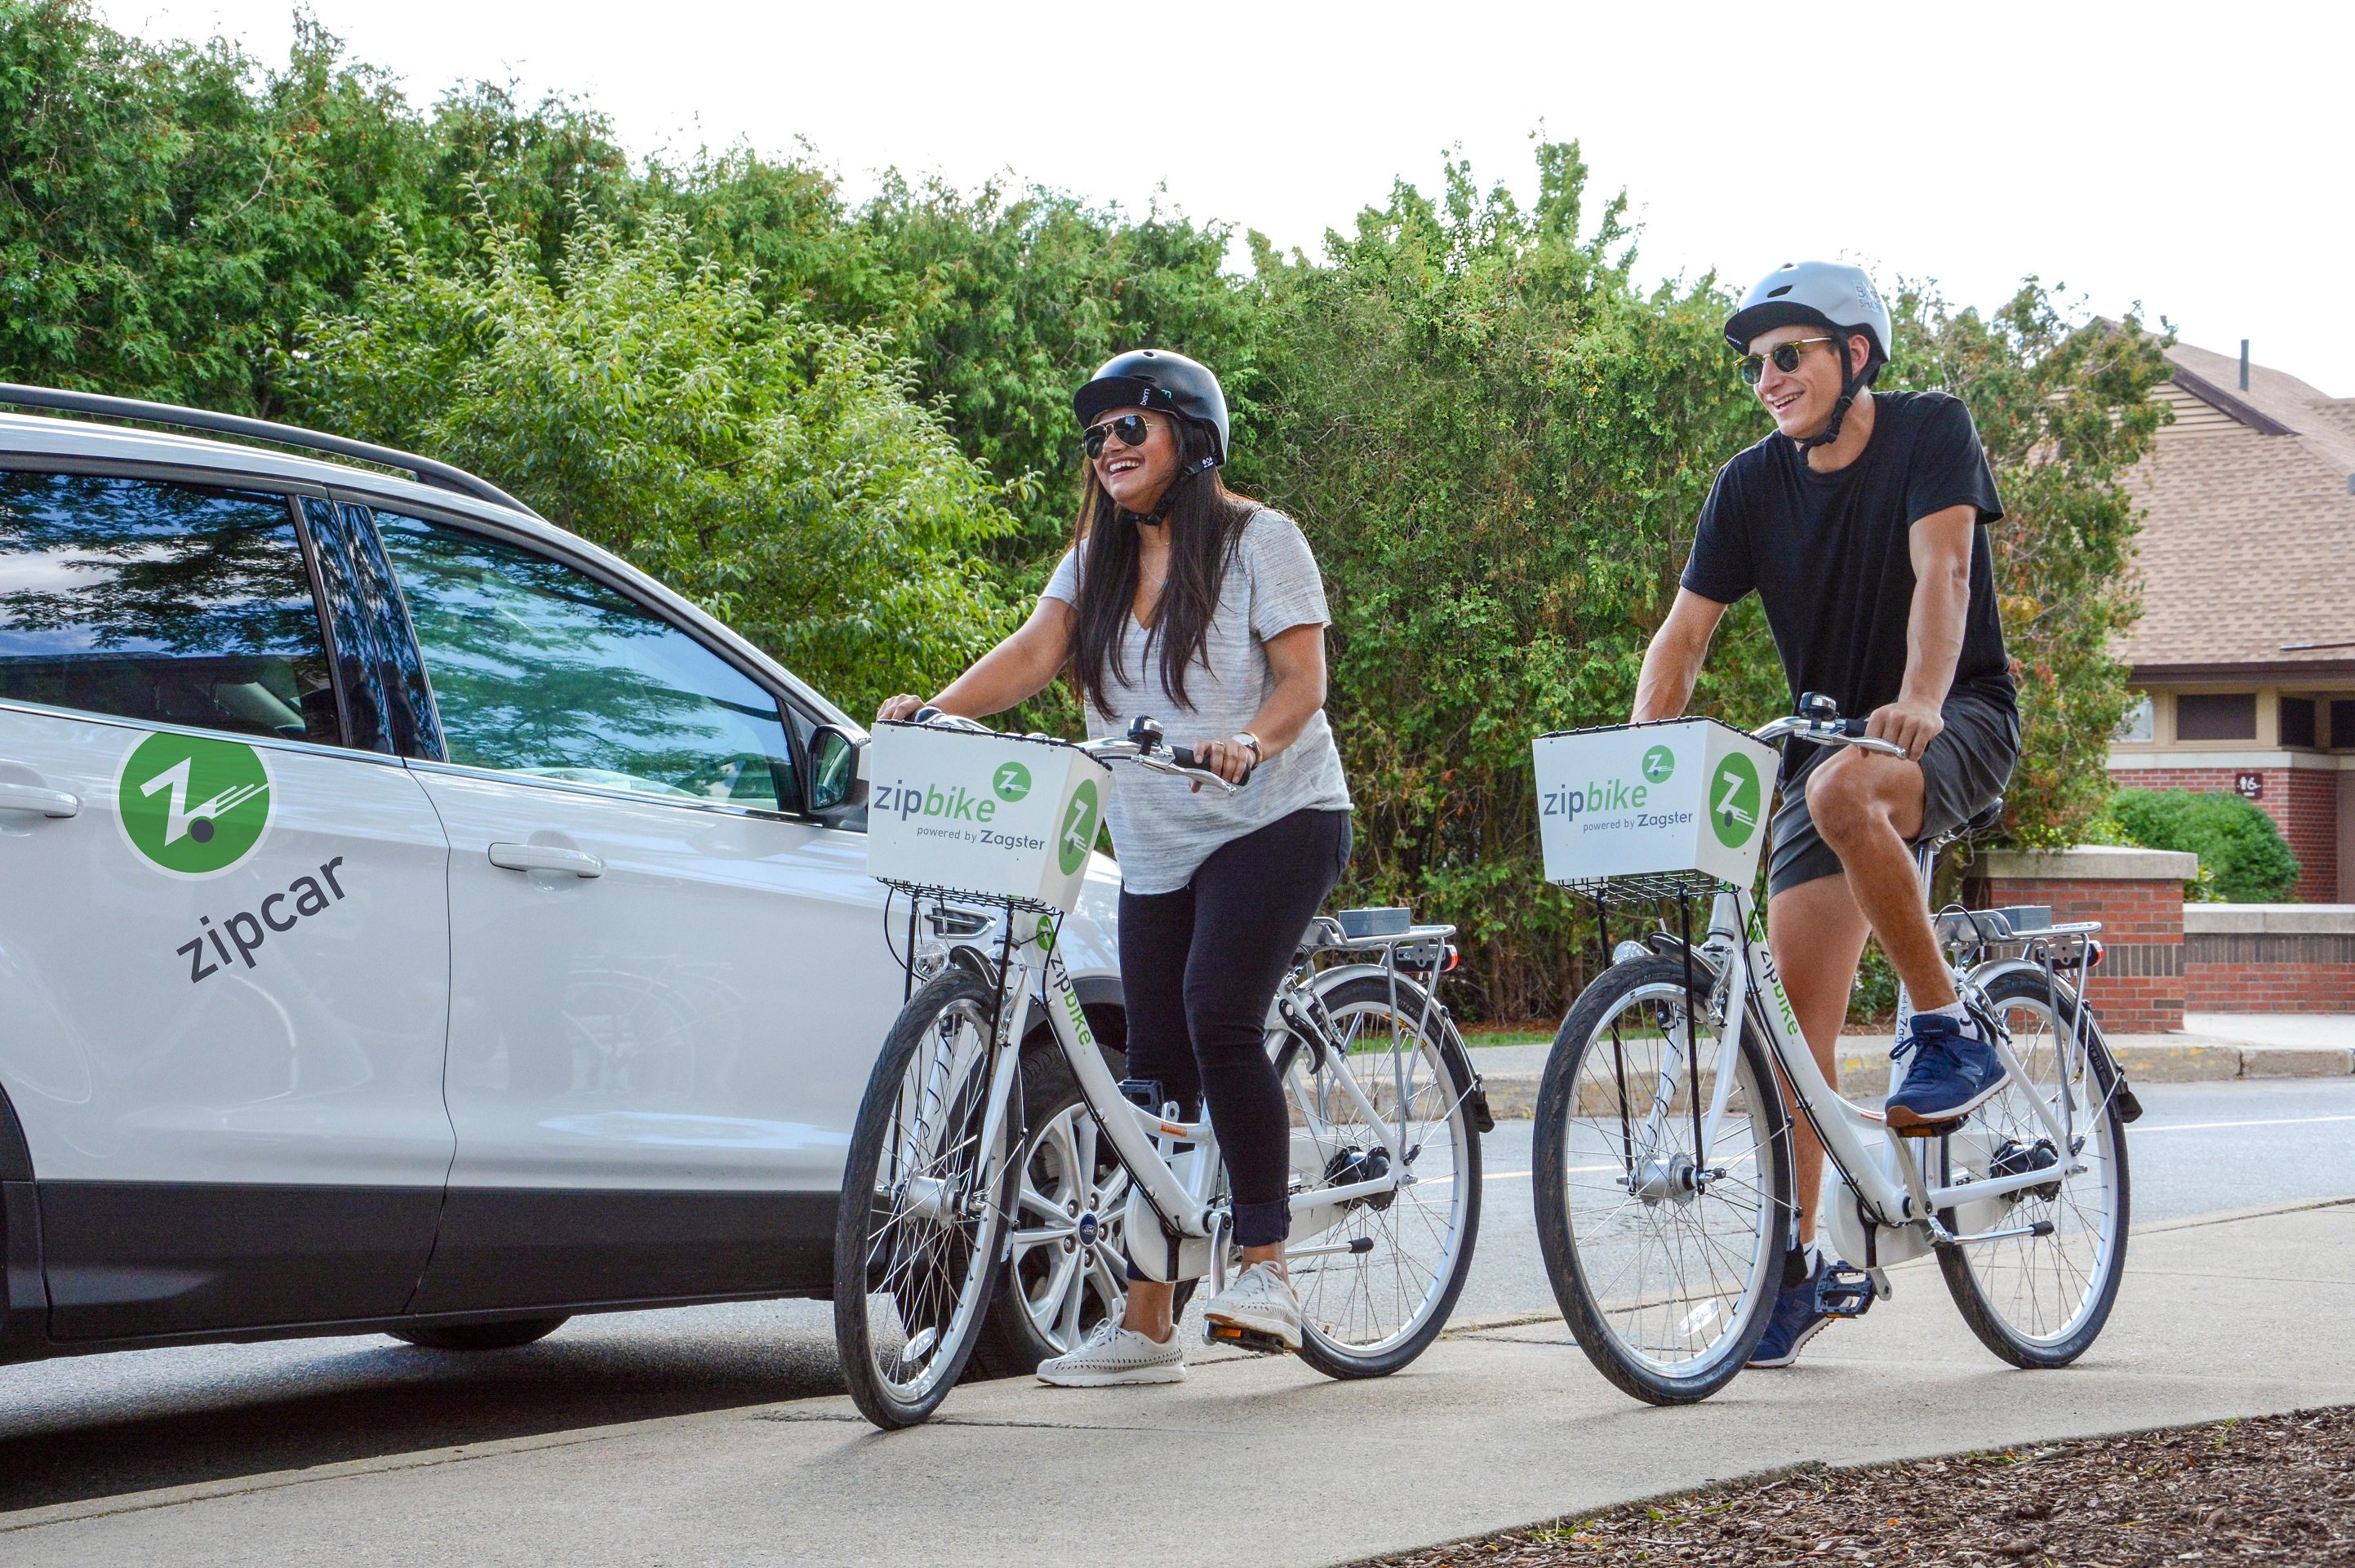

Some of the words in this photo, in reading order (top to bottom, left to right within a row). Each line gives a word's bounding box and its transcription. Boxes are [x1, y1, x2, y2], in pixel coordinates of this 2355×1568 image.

[873, 780, 996, 823] zipbike
[1543, 779, 1648, 822] zipbike
[1583, 819, 1620, 833] powered
[1624, 818, 1635, 830] by
[1637, 811, 1694, 829] Zagster
[917, 826, 961, 840] powered
[964, 831, 977, 843] by
[980, 829, 1046, 851] Zagster
[176, 855, 345, 984] zipcar
[1895, 1018, 1908, 1066] Zager
